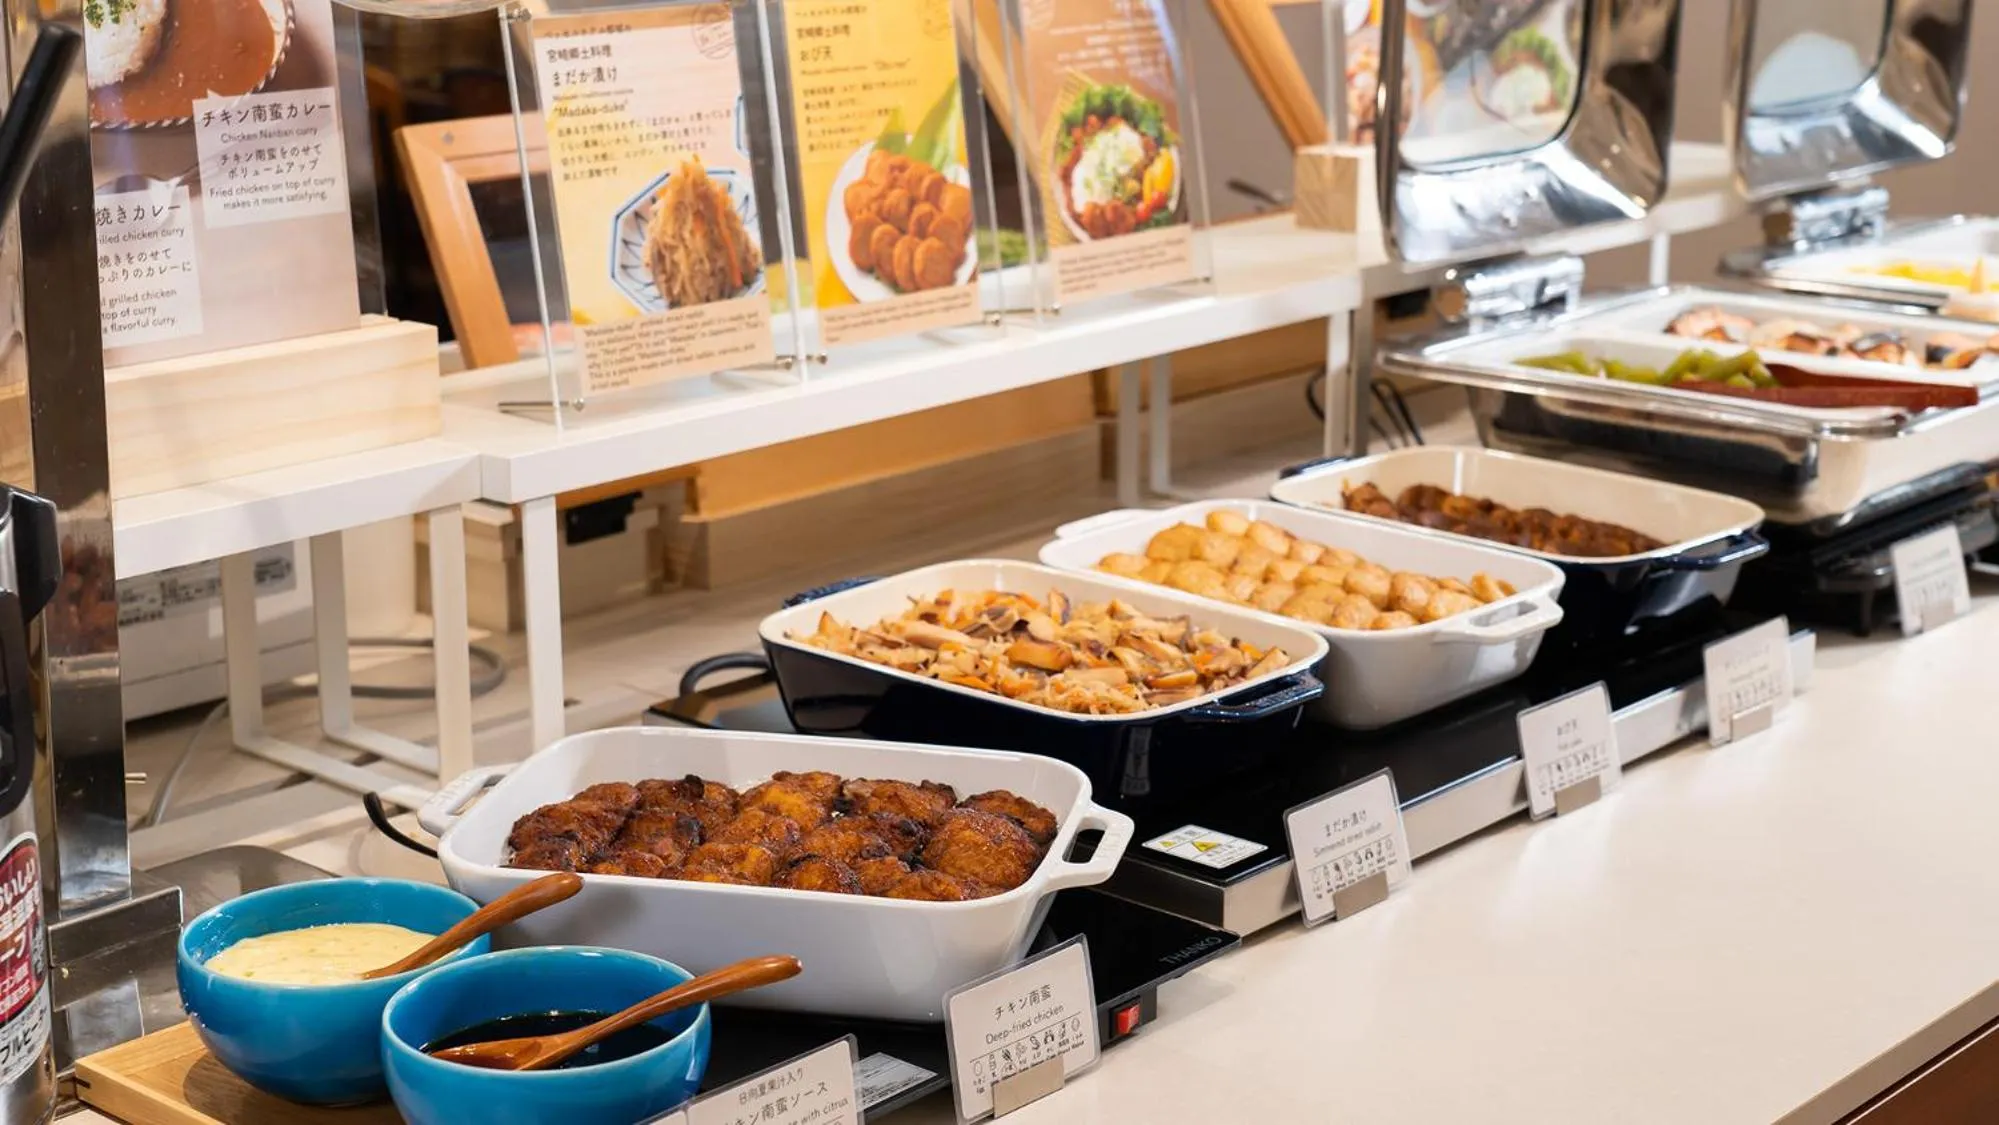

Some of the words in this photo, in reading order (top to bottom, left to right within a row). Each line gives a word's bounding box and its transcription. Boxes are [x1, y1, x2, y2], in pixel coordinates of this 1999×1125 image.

[553, 66, 617, 87] まだか漬け
[202, 102, 331, 127] チキン南蛮カレー
[220, 131, 258, 143] Chicken
[260, 128, 294, 139] Nanban
[295, 127, 318, 137] curry
[220, 143, 322, 165] チキン南蛮をのせて
[228, 158, 319, 180] ボリュームアップ
[210, 186, 233, 198] Fried
[235, 183, 270, 195] chicken
[271, 182, 283, 190] on
[285, 178, 301, 191] top
[302, 177, 312, 187] of
[313, 176, 336, 188] curry
[223, 198, 251, 210] makes
[261, 196, 284, 206] more
[122, 230, 159, 242] chicken
[160, 227, 185, 238] curry
[109, 293, 139, 309] grilled
[141, 288, 177, 301] chicken
[101, 310, 118, 321] top
[120, 307, 131, 318] of
[133, 305, 157, 317] curry
[110, 318, 150, 333] flavorful
[994, 984, 1052, 1022] チキン南蛮
[986, 1019, 1032, 1044] Deep-fried
[1033, 1004, 1064, 1025] chicken
[739, 1067, 804, 1105] 日向夏果汁入り
[726, 1081, 828, 1125] キン南蛮ソース
[801, 1108, 821, 1125] with
